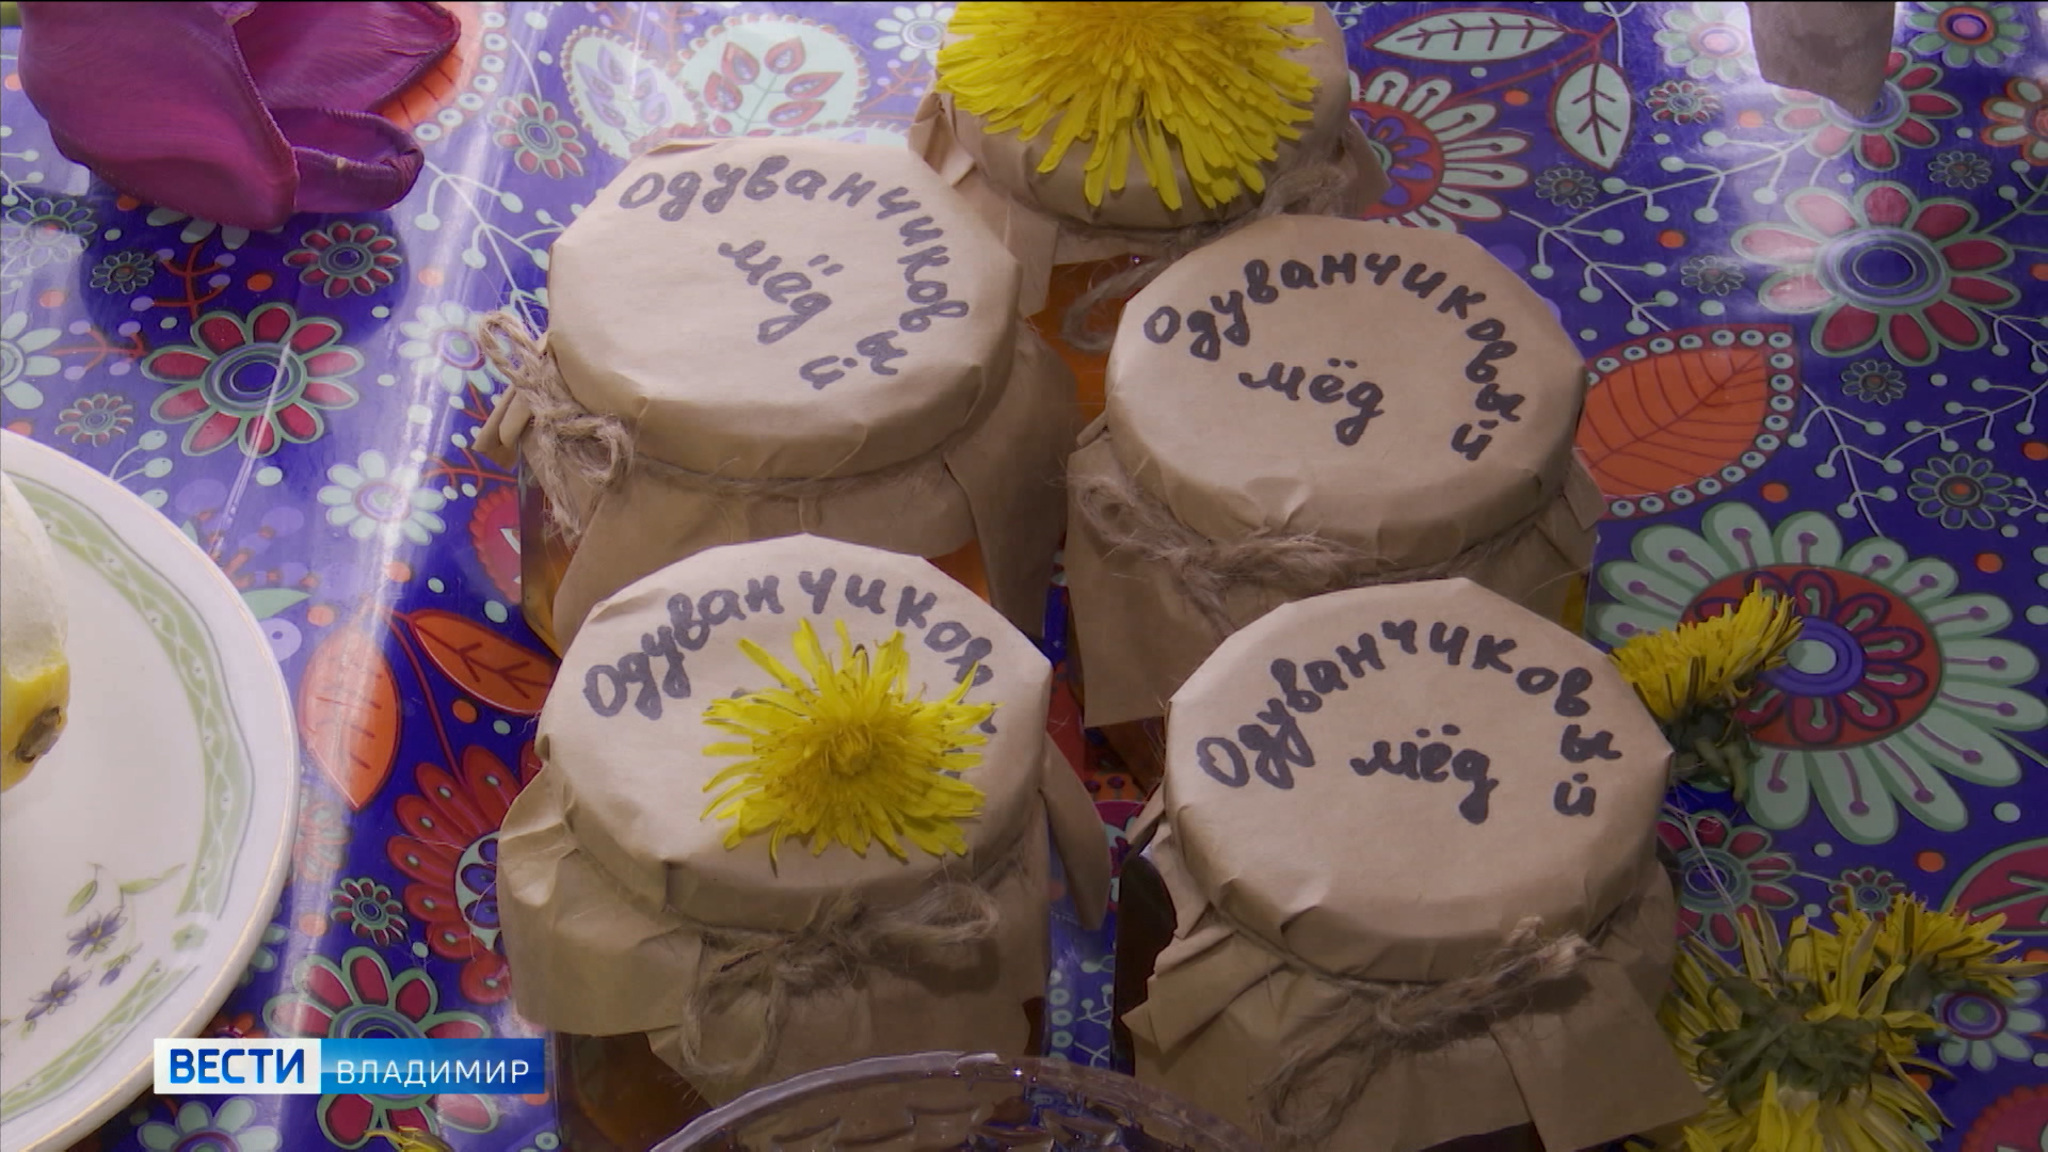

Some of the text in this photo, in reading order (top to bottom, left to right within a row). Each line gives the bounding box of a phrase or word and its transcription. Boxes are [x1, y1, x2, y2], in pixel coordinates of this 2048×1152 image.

[718, 240, 844, 345] мёд
[1238, 357, 1384, 446] мёд
[1197, 619, 1622, 817] Одуванчиковый
[1350, 724, 1498, 824] мёд
